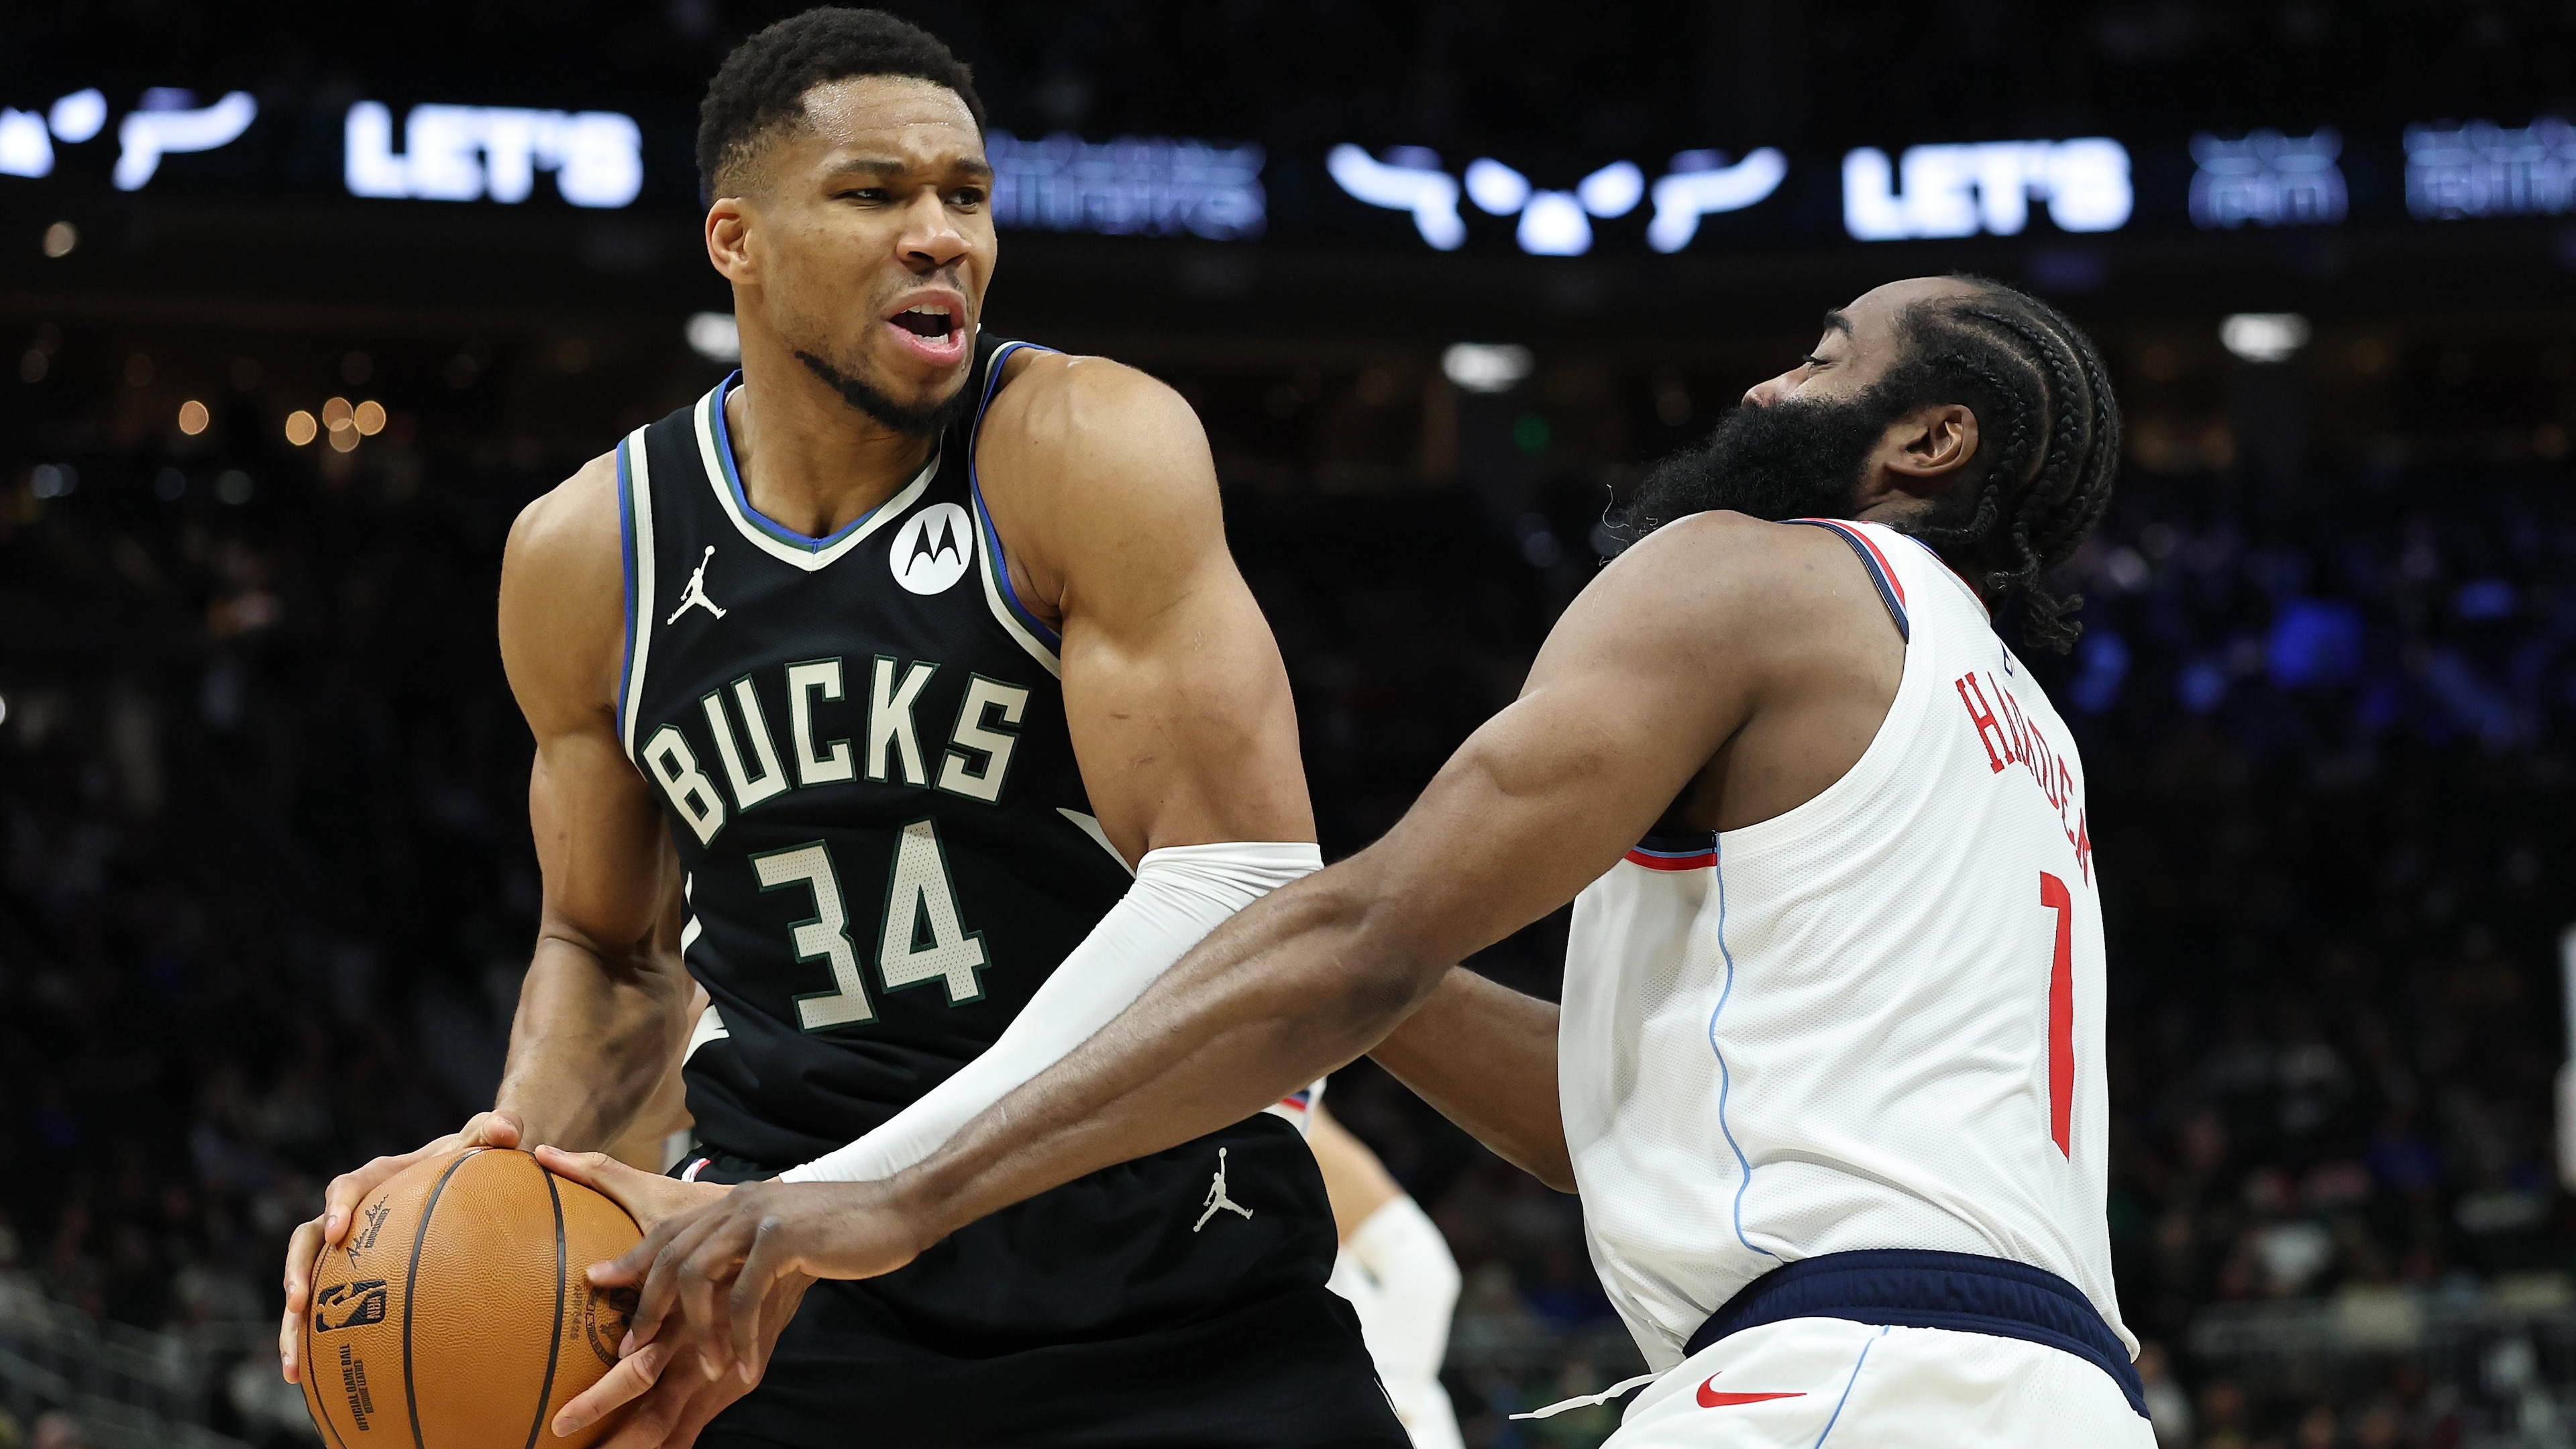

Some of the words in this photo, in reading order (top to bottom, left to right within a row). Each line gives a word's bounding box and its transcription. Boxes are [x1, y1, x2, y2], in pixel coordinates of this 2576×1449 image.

[344, 100, 643, 209] LET'S
[1842, 137, 2134, 241] LET'S
[641, 654, 1031, 849] BUCKS
[747, 816, 991, 1032] 34
[2040, 871, 2075, 1163] 1
[366, 1295, 382, 1320] NBA
[339, 1344, 352, 1366] BALL
[342, 1367, 357, 1393] GAME
[354, 1359, 366, 1386] LEATHER
[347, 1393, 370, 1432] OFFICIAL
